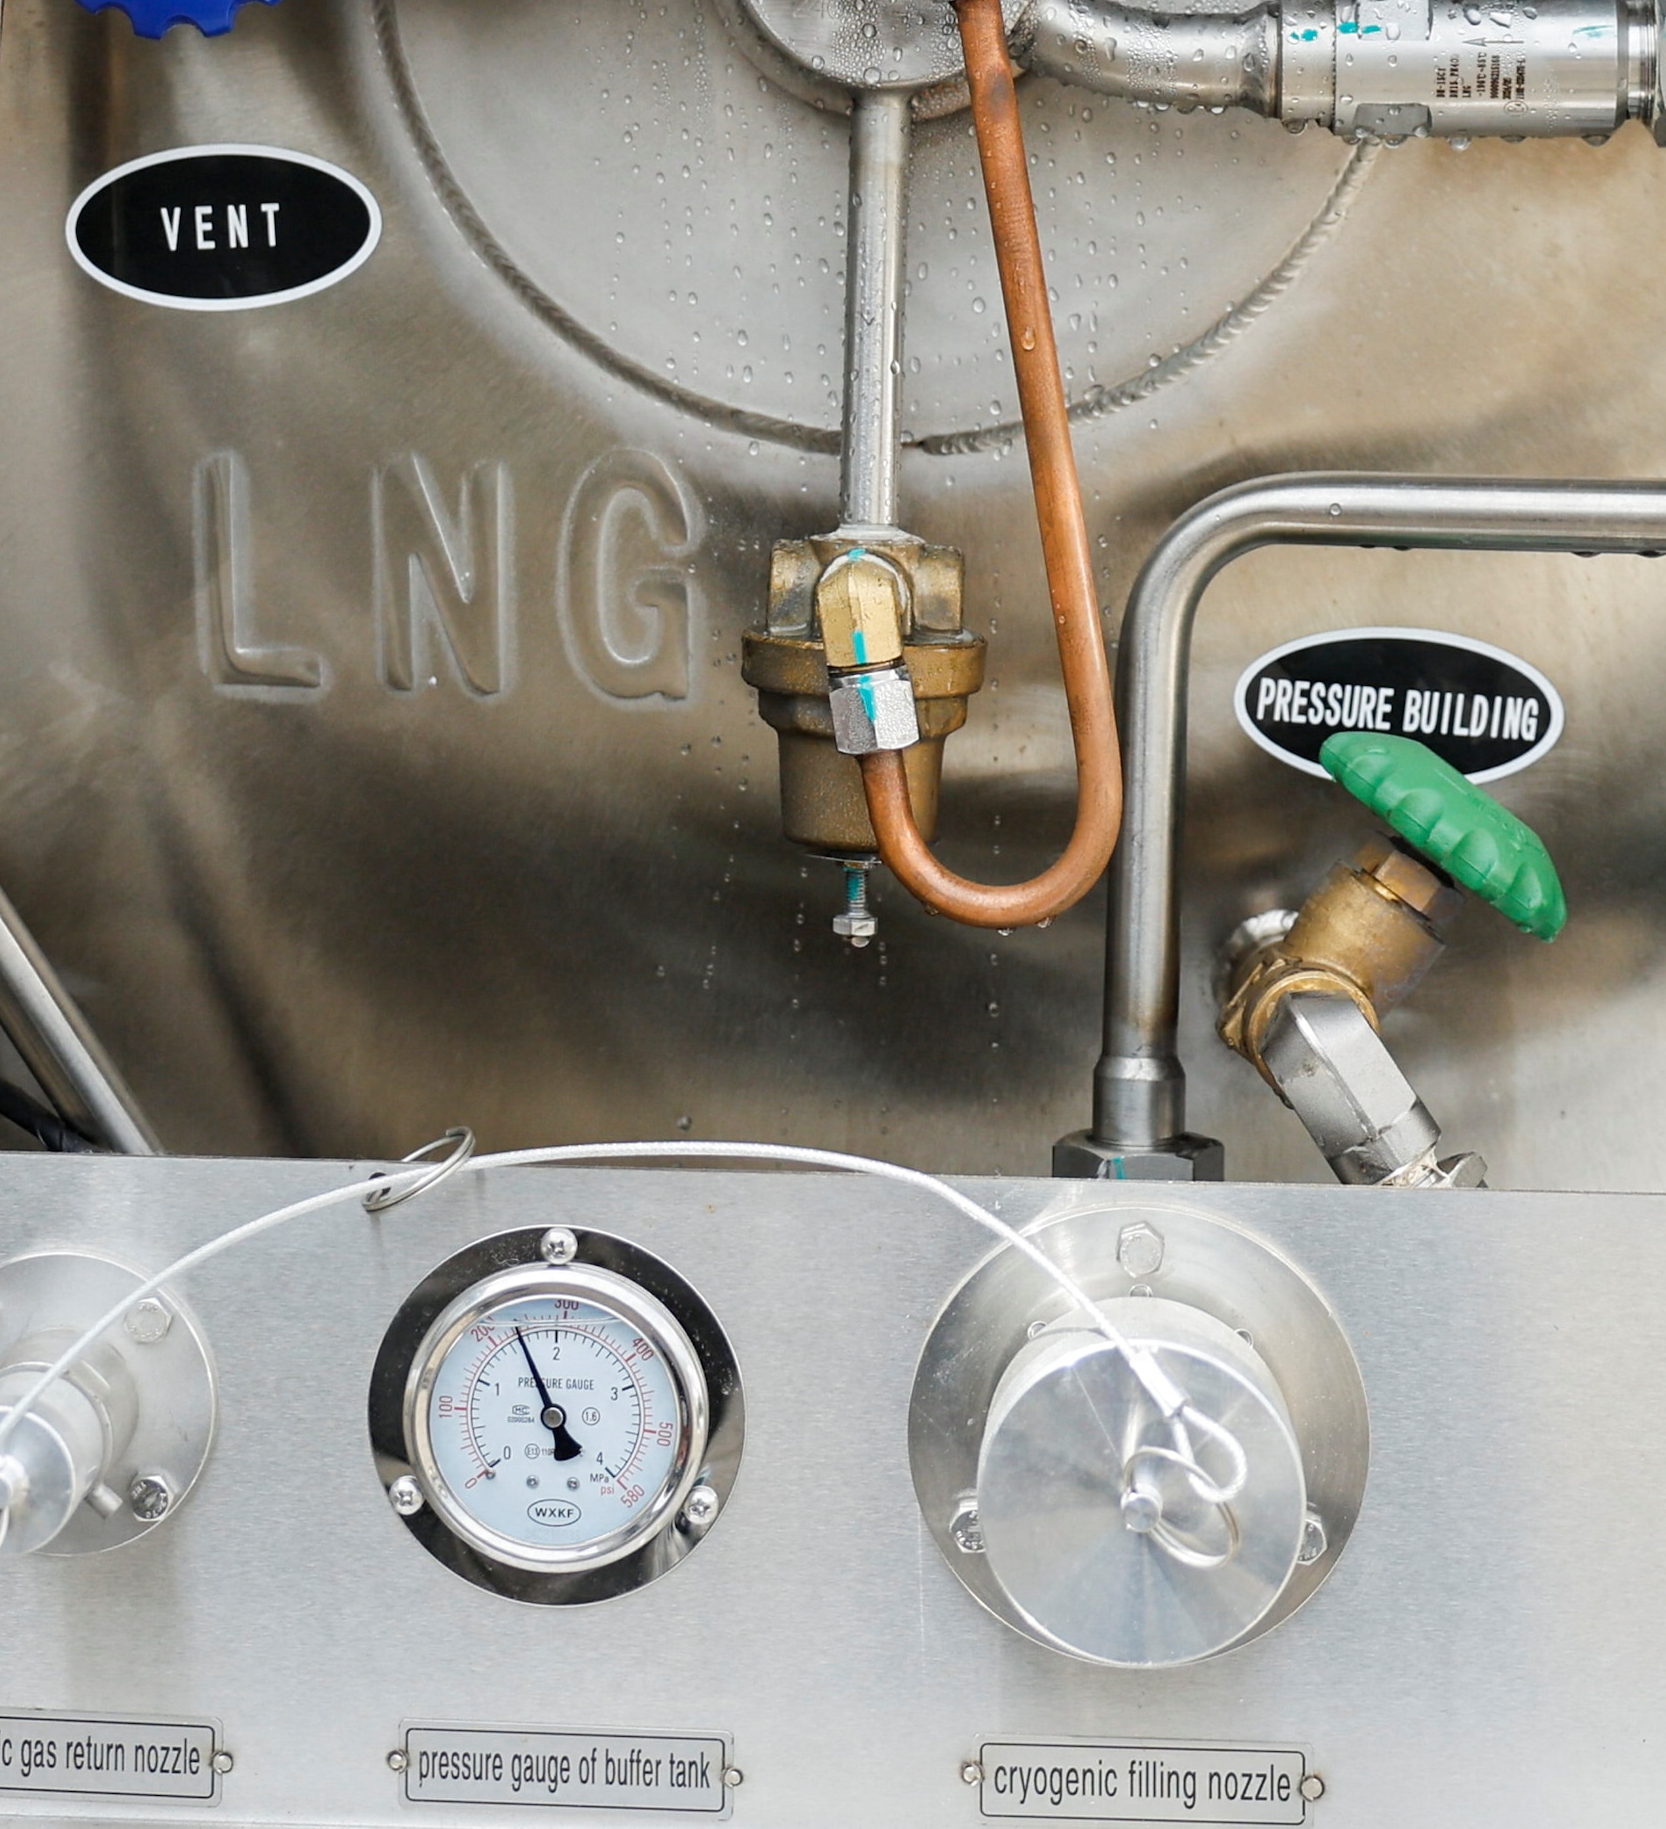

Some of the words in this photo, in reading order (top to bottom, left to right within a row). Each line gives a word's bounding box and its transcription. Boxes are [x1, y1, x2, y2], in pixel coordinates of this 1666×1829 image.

[160, 202, 280, 252] VENT
[192, 447, 708, 709] LNG
[1255, 677, 1394, 731] PRESSURE
[1402, 689, 1540, 742] BUILDING
[553, 1347, 560, 1361] 2
[632, 1337, 654, 1361] 400
[518, 1377, 562, 1389] PRESURE
[566, 1378, 594, 1390] GAUGE
[610, 1387, 618, 1401] 3
[439, 1395, 453, 1418] 100
[657, 1421, 673, 1447] 500
[504, 1446, 511, 1460] 0
[596, 1452, 603, 1465] 4
[590, 1473, 610, 1483] MPa
[600, 1484, 615, 1496] psi
[621, 1485, 645, 1509] 580
[535, 1507, 576, 1518] WXKF
[20, 1741, 57, 1777] gas
[65, 1736, 125, 1773] return
[134, 1738, 200, 1776] nozzle
[418, 1749, 502, 1788] pressure
[511, 1757, 571, 1793] gauge
[578, 1748, 598, 1784] of
[604, 1748, 662, 1787] buffer
[669, 1751, 711, 1789] tank
[993, 1759, 1118, 1806] cryogenic
[1128, 1760, 1196, 1809] filling
[1208, 1765, 1291, 1802] nozzle
